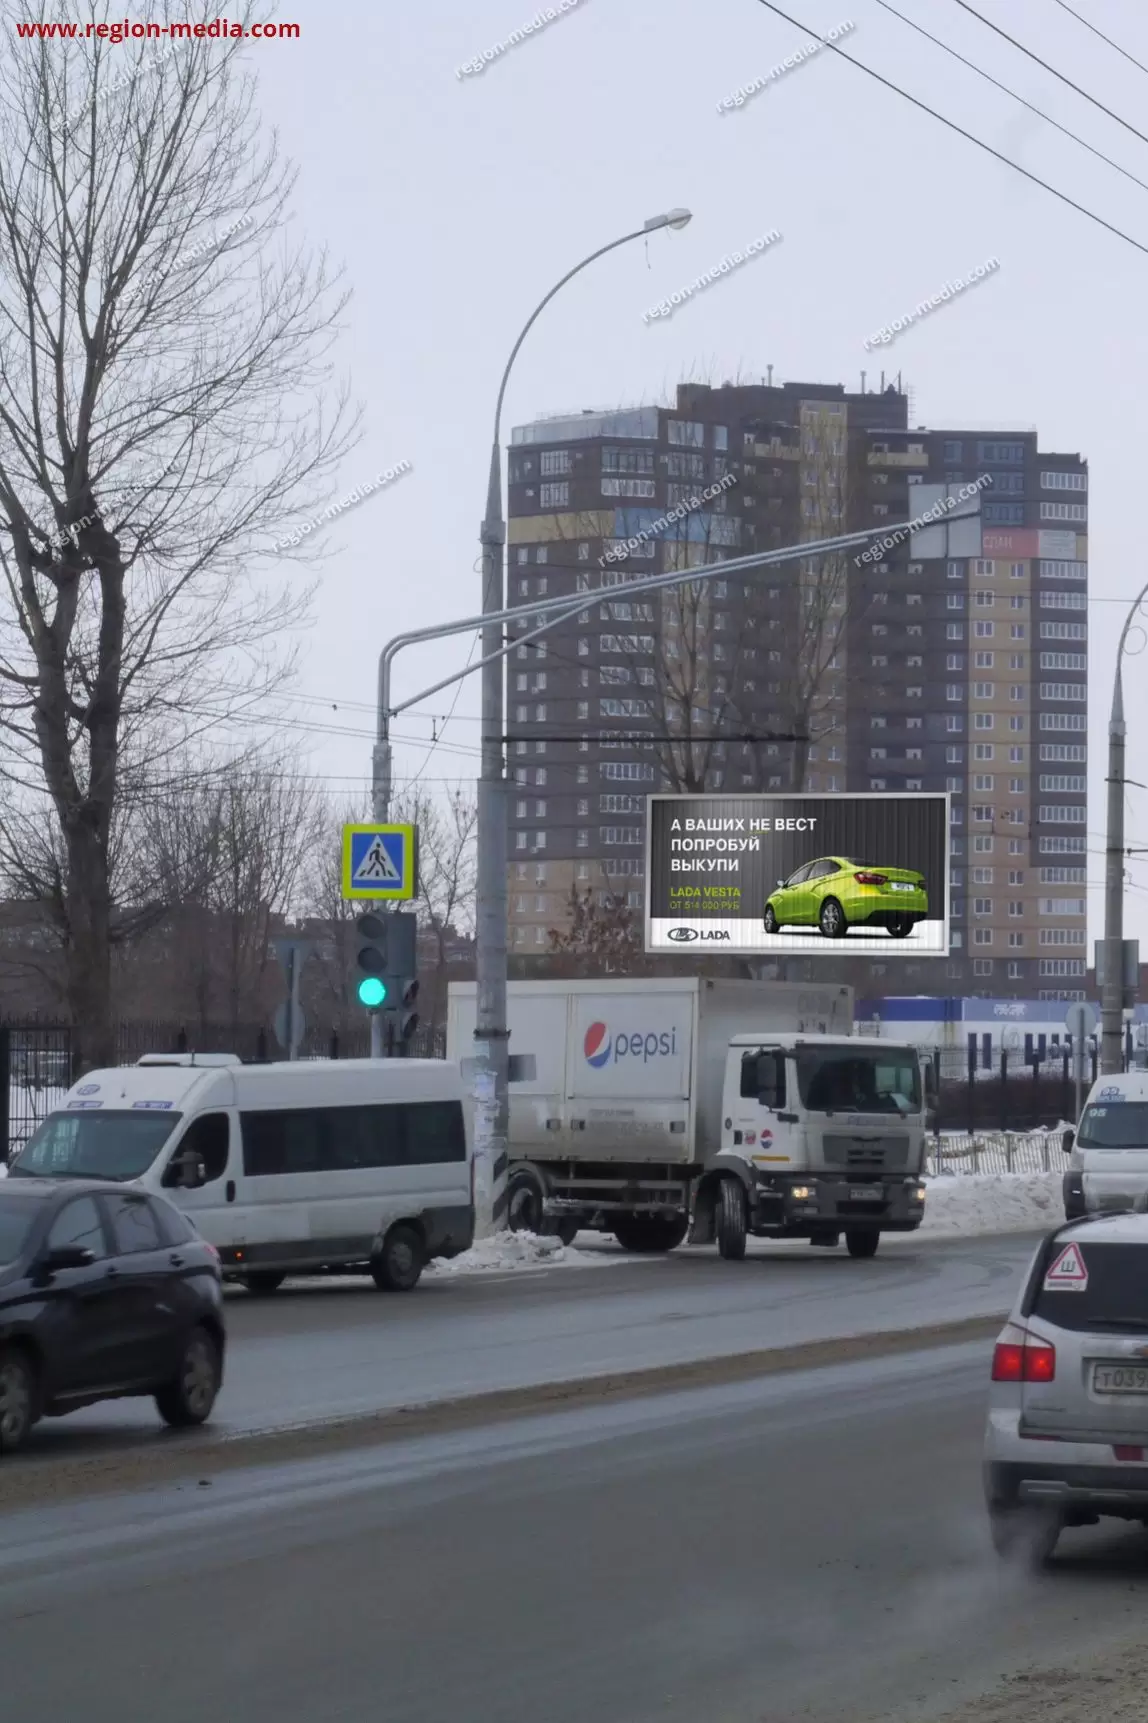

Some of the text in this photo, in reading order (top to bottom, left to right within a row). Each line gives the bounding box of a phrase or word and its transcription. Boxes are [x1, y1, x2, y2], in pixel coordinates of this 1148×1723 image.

[671, 818, 817, 831] А ВАШИХ НЕ ВЕСТ
[671, 836, 760, 851] ПОПРОБУЙ
[671, 859, 739, 872] ВЫКУПИ
[670, 887, 741, 897] LADA VESTA
[700, 931, 730, 941] LADA
[614, 1026, 677, 1063] pepsi
[1061, 1260, 1076, 1273] Ш
